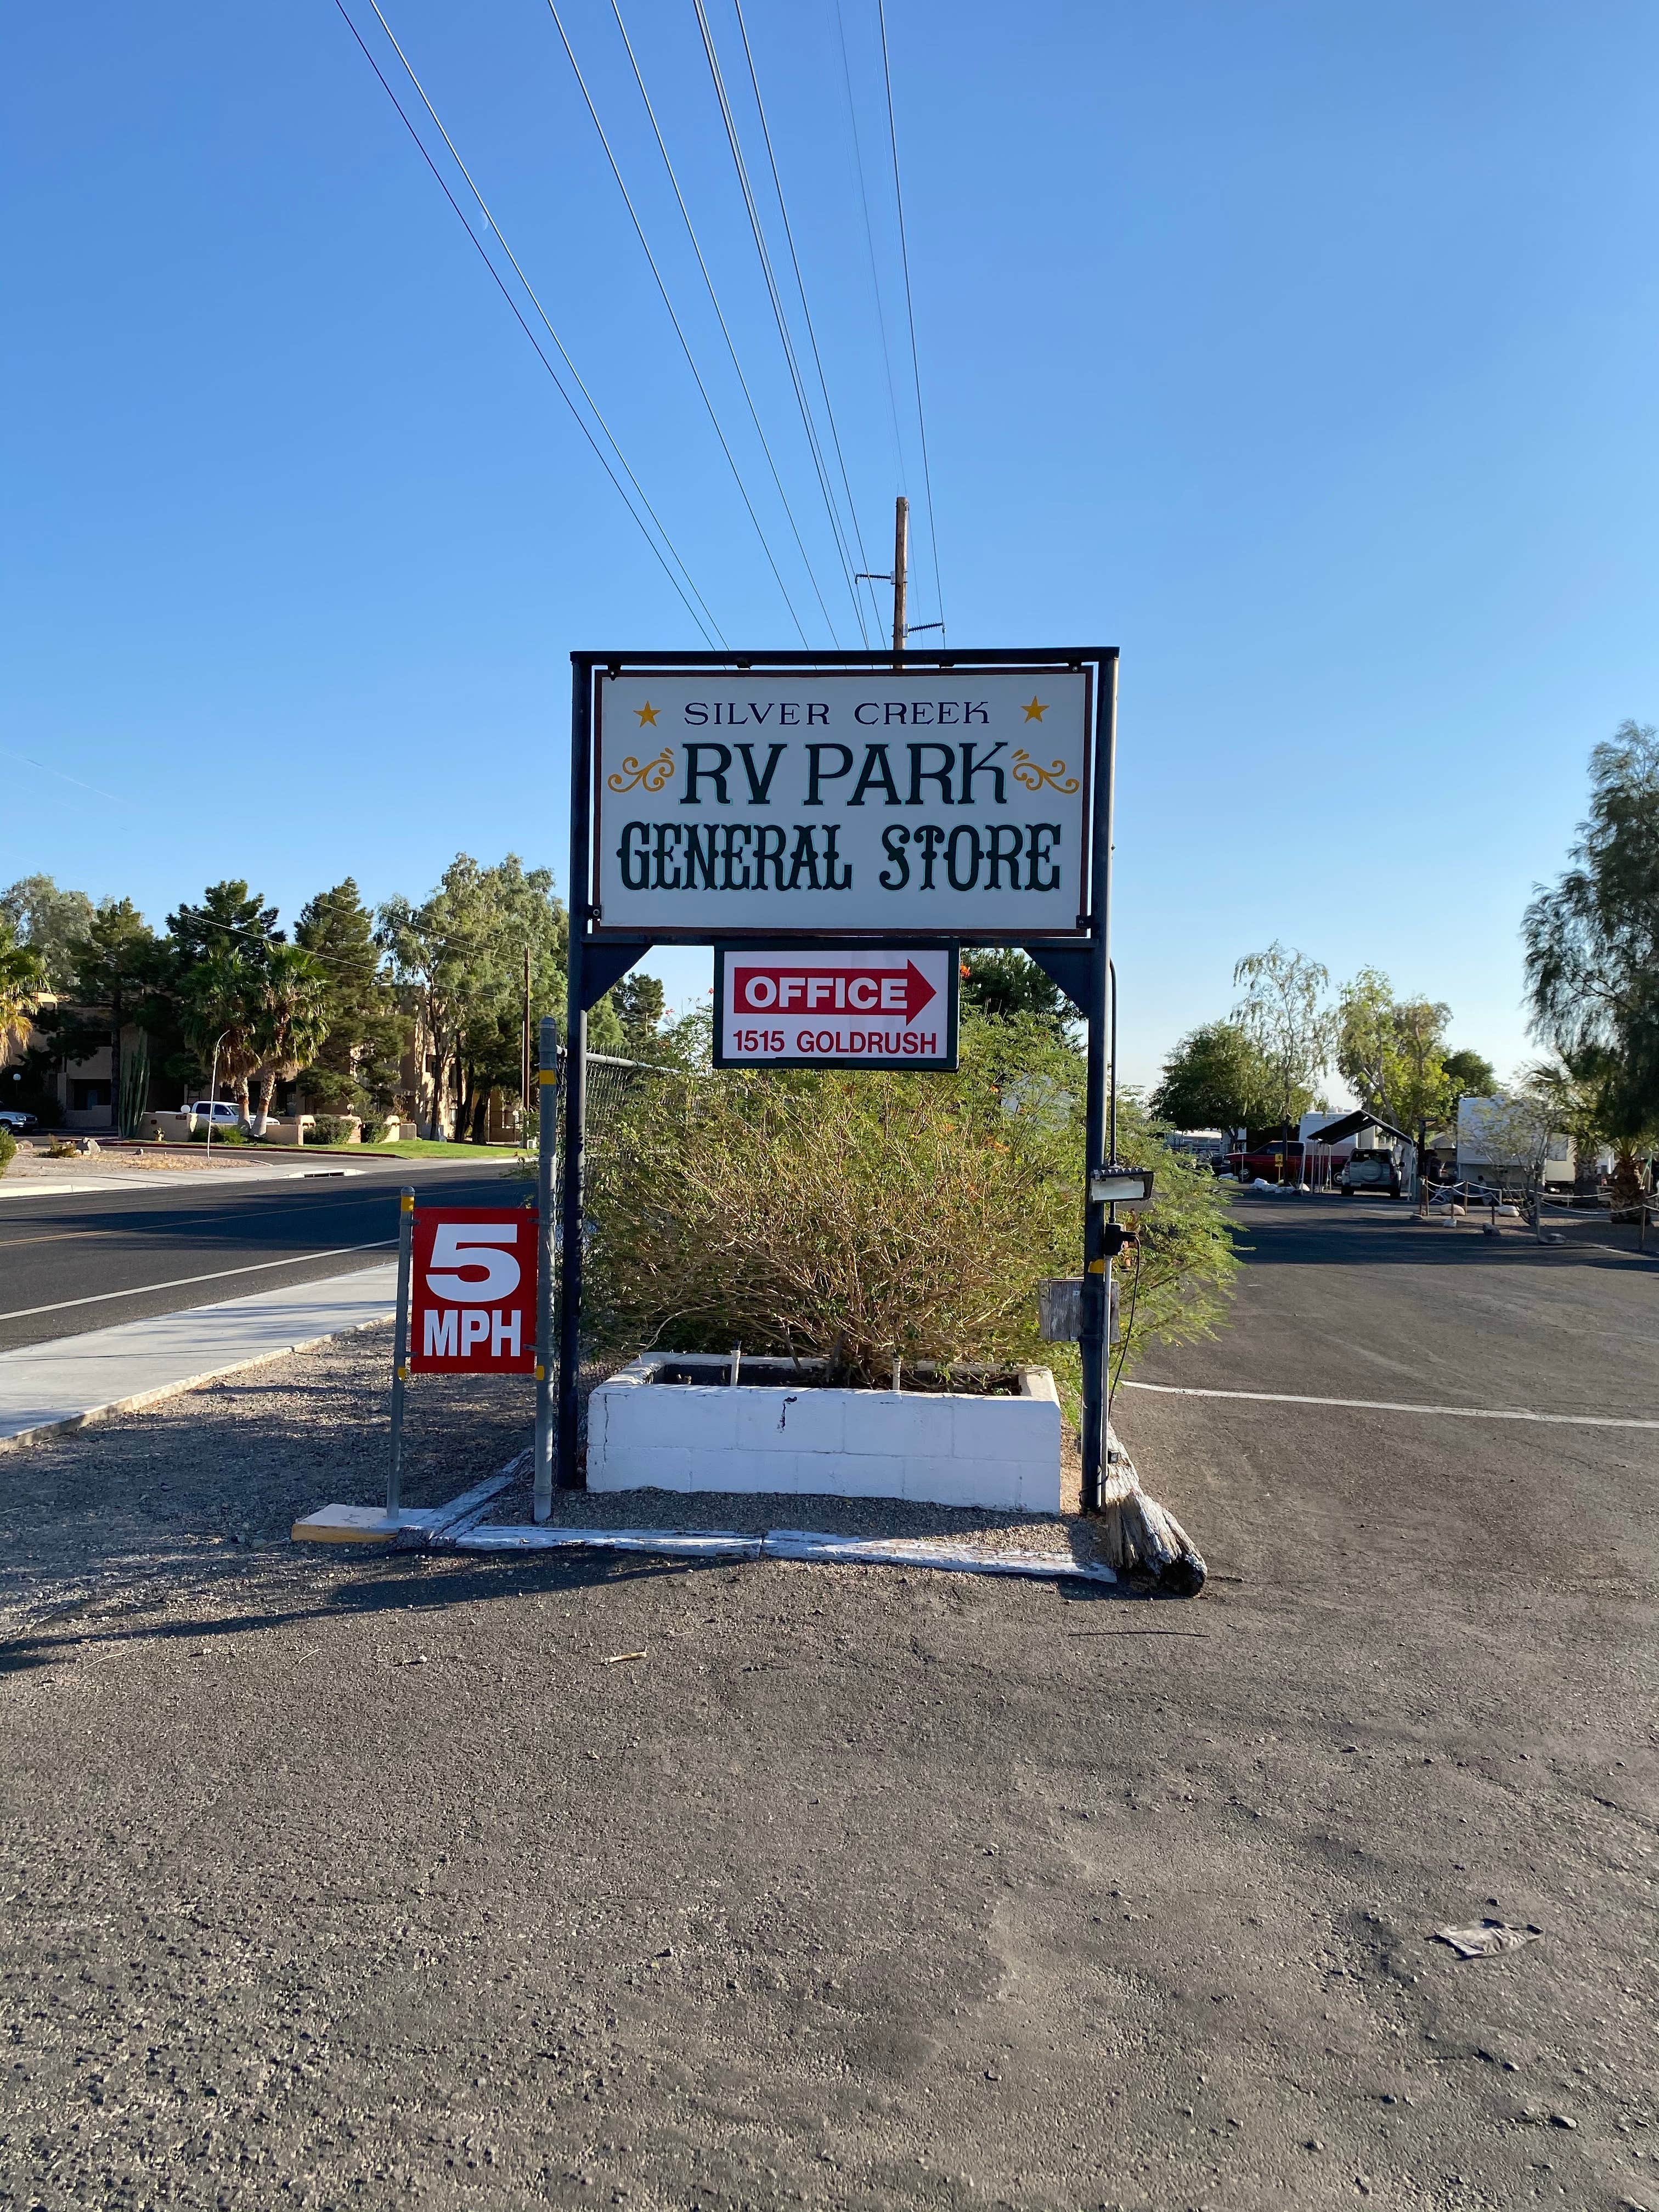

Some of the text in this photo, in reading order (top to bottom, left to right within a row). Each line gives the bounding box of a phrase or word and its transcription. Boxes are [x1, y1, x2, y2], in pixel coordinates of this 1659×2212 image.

[684, 701, 990, 726] SILVER CREEK
[679, 742, 1008, 806] RV PARK
[616, 821, 1062, 892] GENERAL STORE
[745, 976, 908, 1009] OFFICE
[734, 1030, 936, 1054] 1515 GOLDRUSH
[426, 1223, 521, 1302] 5
[424, 1310, 521, 1357] MPH
